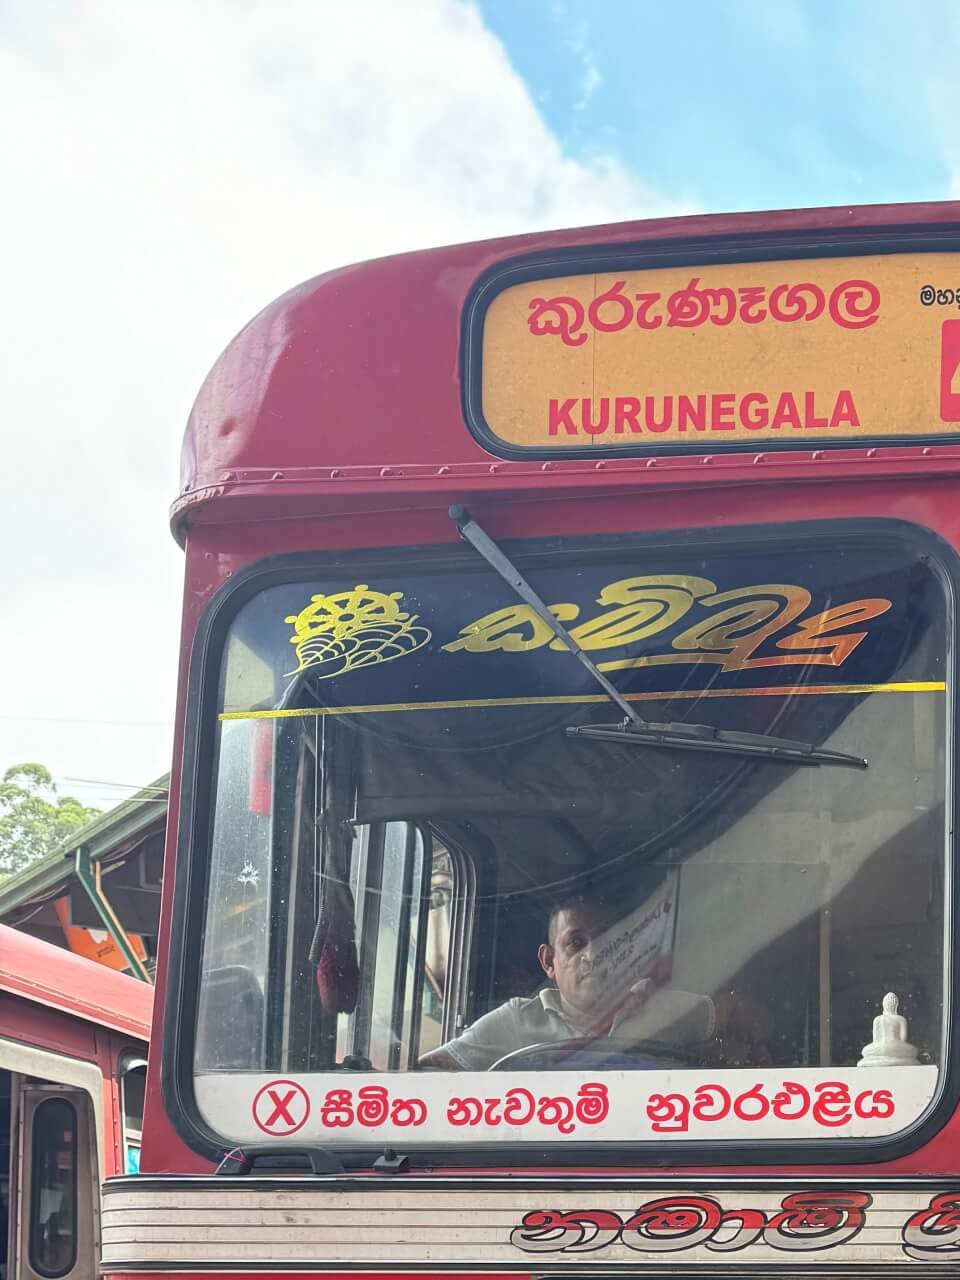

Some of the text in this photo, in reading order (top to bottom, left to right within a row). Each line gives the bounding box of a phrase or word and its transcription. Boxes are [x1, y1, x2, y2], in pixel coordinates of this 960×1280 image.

[528, 280, 881, 347] කුරුණෑගල
[548, 391, 860, 436] KURUNEGALA
[320, 1085, 429, 1128] සීමිත
[446, 1082, 611, 1135] නැවතුම්
[645, 1081, 896, 1133] නුවරඑළිය
